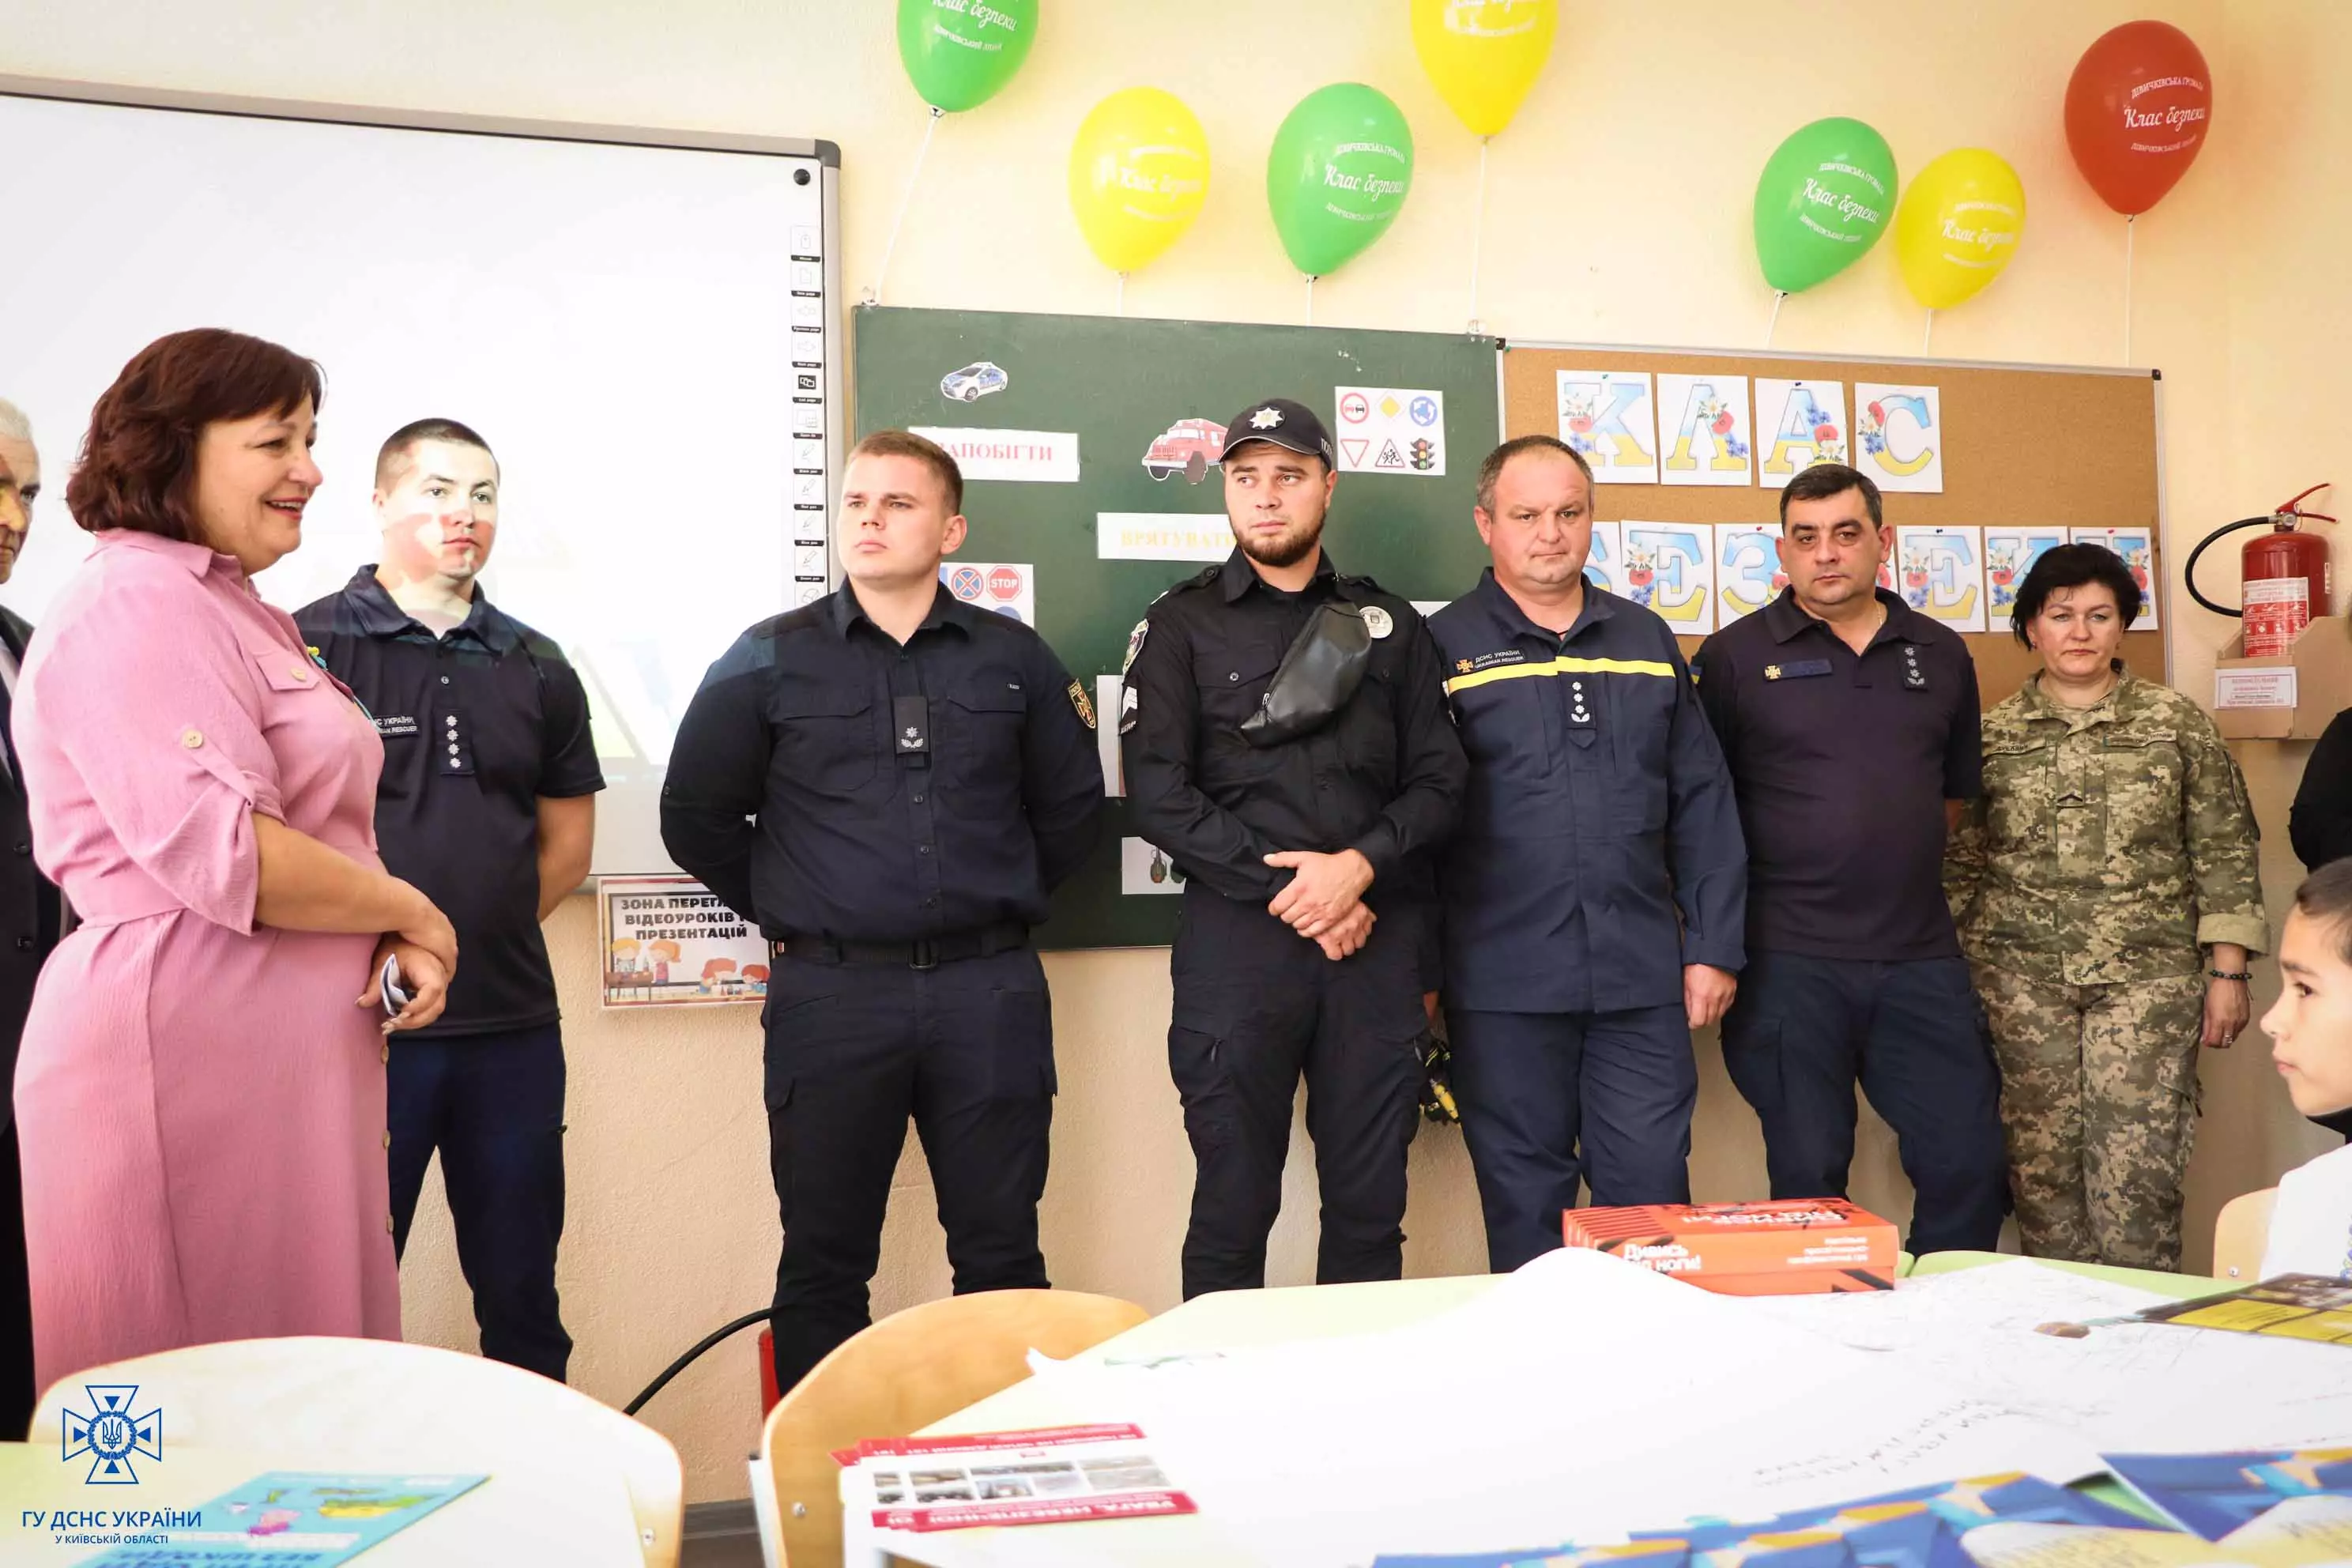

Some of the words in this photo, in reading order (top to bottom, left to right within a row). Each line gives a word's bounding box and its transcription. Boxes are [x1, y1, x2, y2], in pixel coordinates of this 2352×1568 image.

[970, 0, 1018, 32] безпеки
[2124, 107, 2163, 129] Клас
[2166, 106, 2205, 133] безпеки
[1324, 162, 1362, 190] Клас
[1803, 177, 1838, 207] Клас
[1838, 194, 1880, 224] безпеки
[1563, 383, 1934, 477] КЛАС
[939, 443, 1053, 461] АПОБІГТИ
[990, 578, 1018, 589] STOP
[1475, 654, 1493, 663] ДСНС
[1494, 650, 1521, 658] УКРАЇНИ
[383, 715, 415, 727] УКРАЇНИ
[621, 898, 665, 910] ЗОНА
[624, 911, 735, 926] ВІДЕОУРОКІВ
[635, 924, 748, 940] ПРЕЗЕНТАЦІЙ
[1624, 1243, 1689, 1260] Дивись
